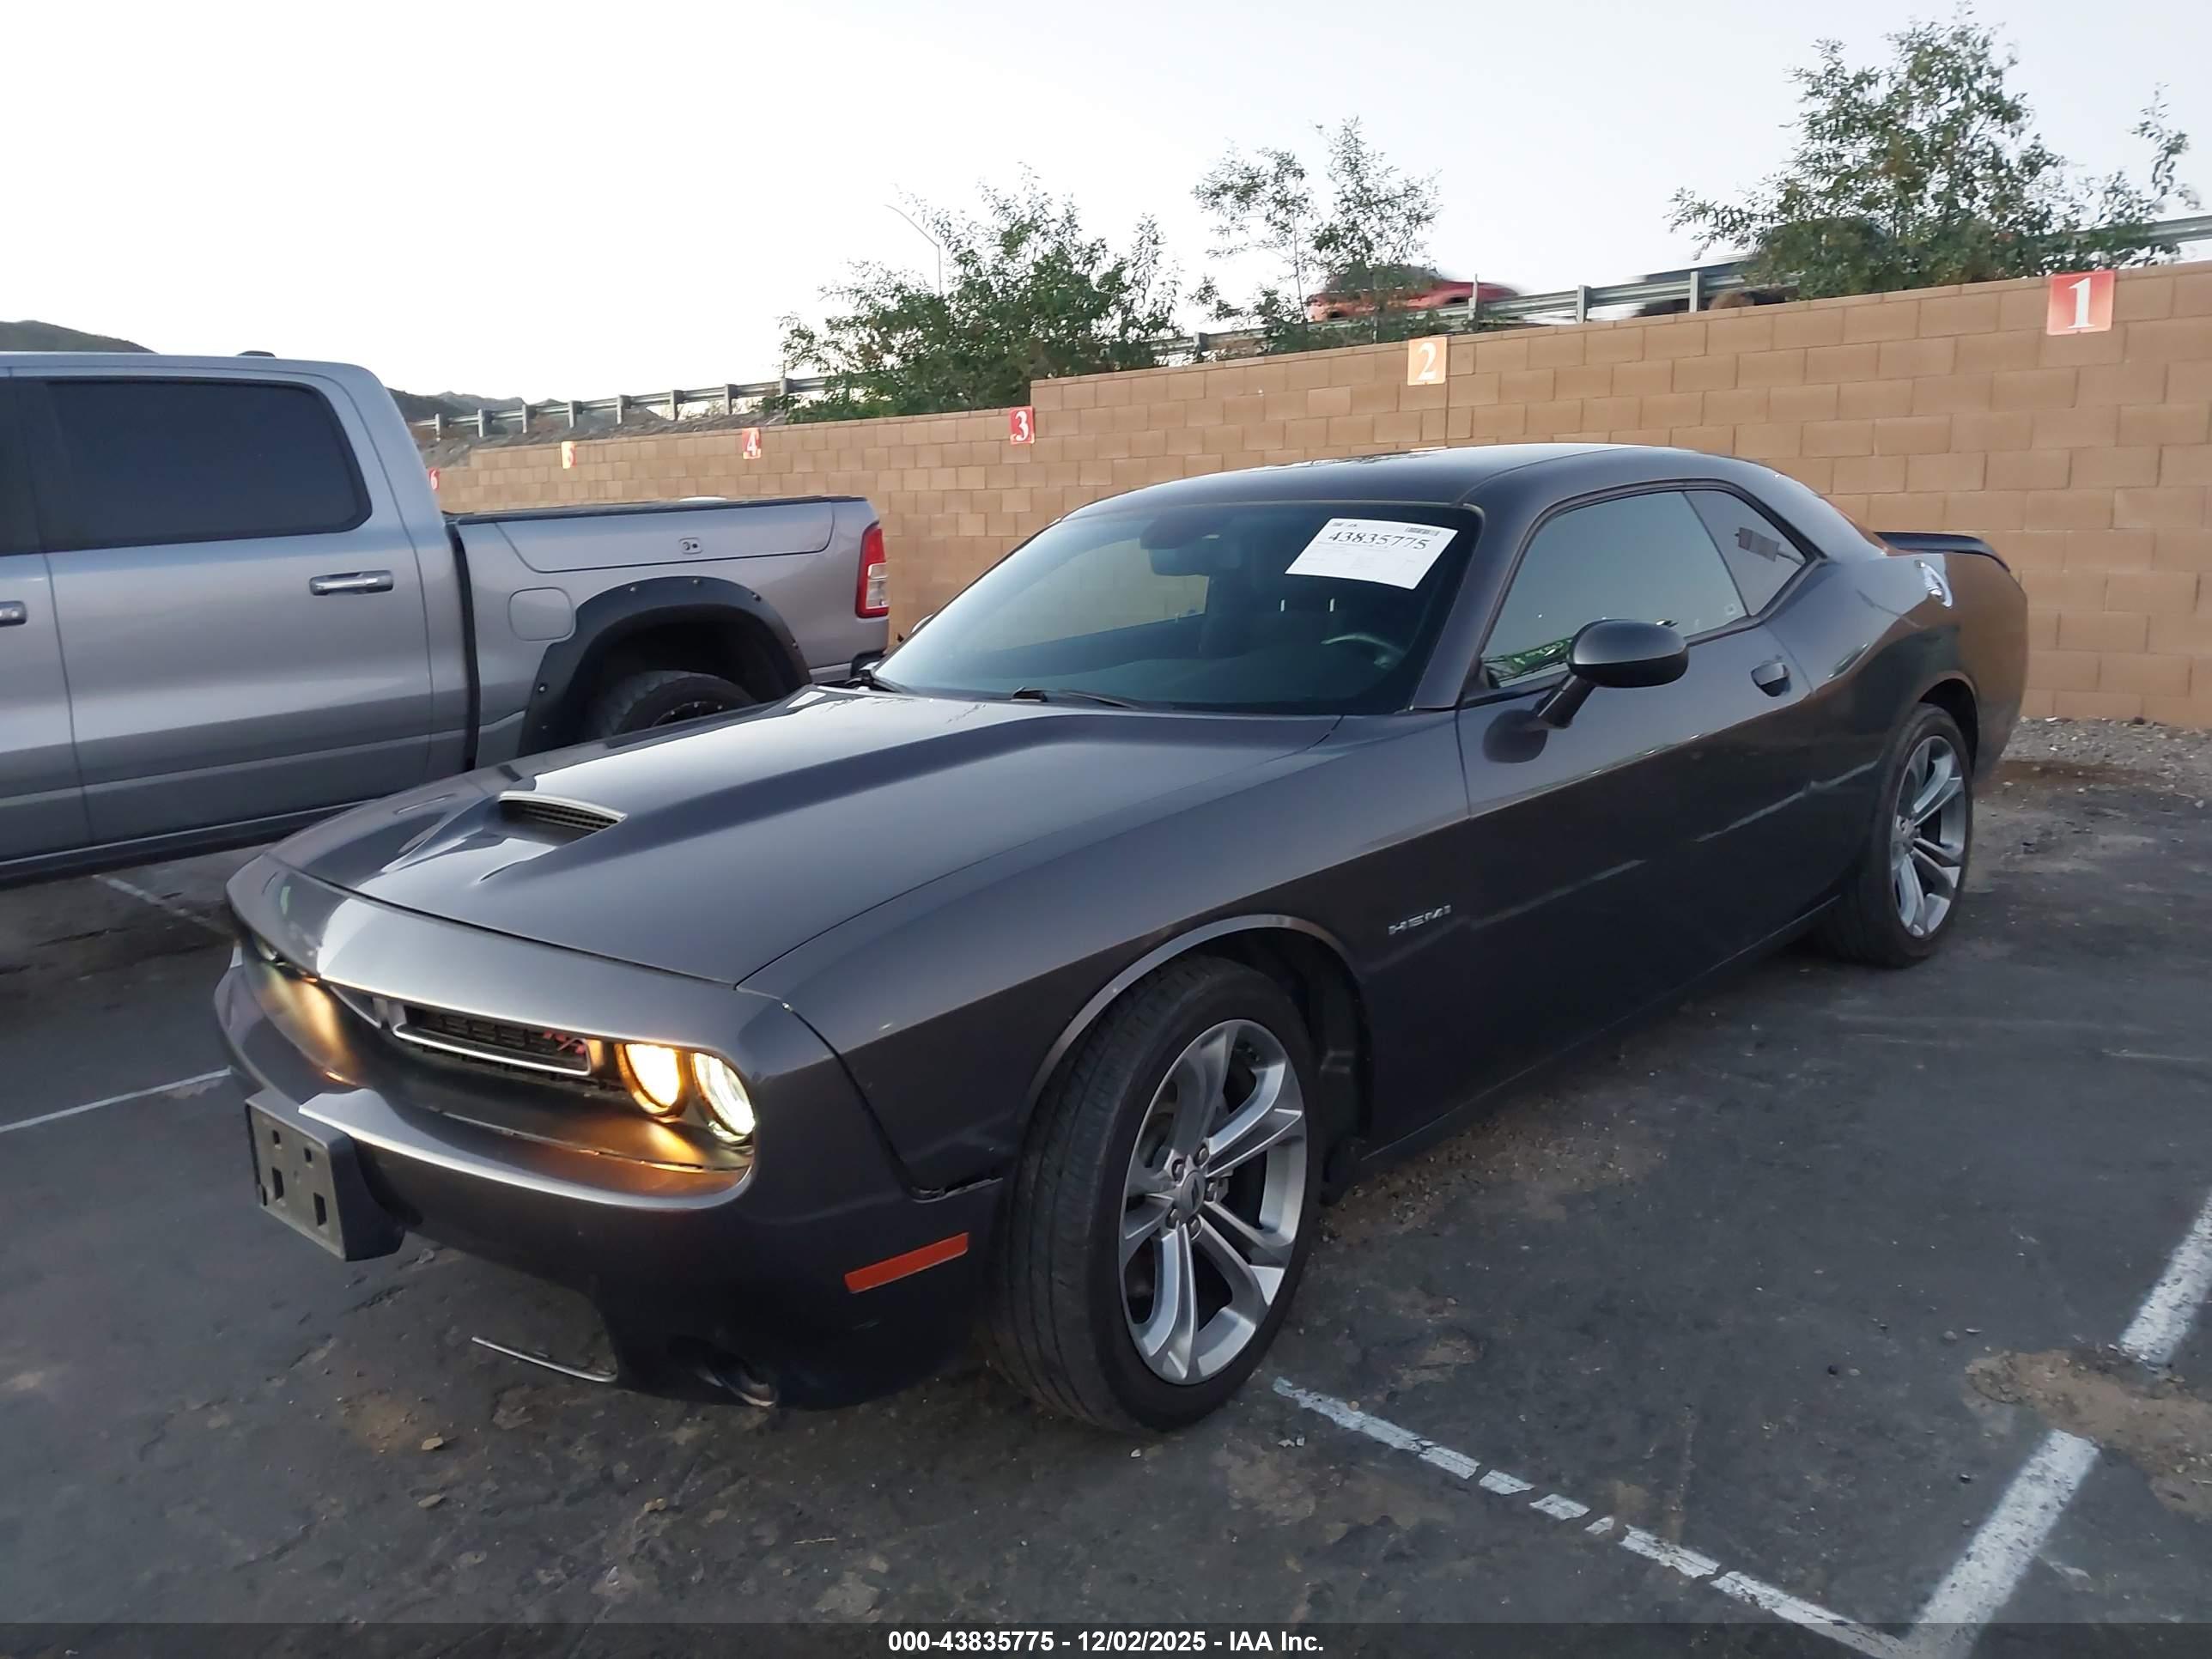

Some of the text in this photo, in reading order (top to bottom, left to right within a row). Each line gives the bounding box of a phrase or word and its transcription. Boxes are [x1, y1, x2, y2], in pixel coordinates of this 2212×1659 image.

[2067, 276, 2096, 329] 1
[1417, 342, 1437, 380] 2
[1015, 410, 1030, 441] 3
[746, 431, 758, 457] 4
[1328, 531, 1431, 550] 43835775
[1389, 904, 1451, 935] HEMI
